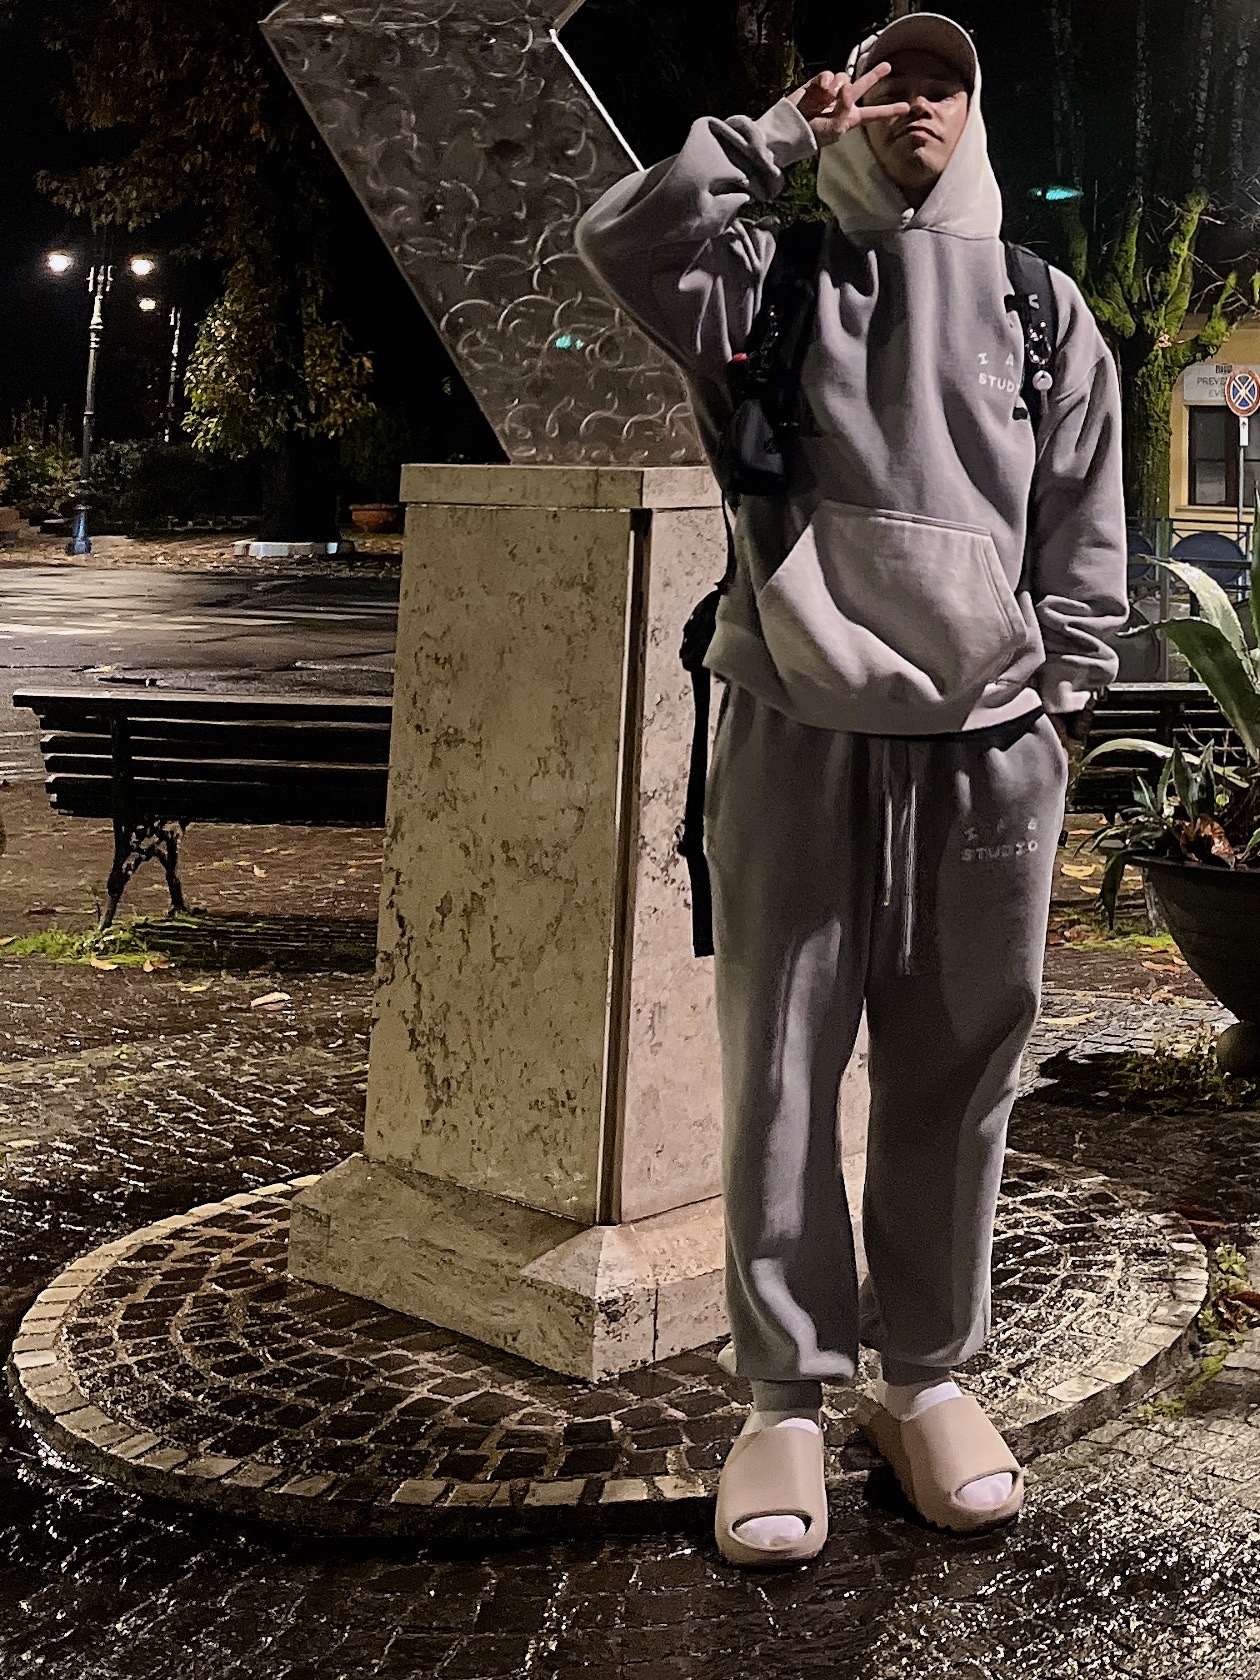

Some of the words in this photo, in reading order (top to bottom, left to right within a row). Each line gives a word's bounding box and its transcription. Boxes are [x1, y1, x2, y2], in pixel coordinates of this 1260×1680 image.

[979, 372, 1021, 393] STUD
[1196, 376, 1227, 386] PREVE
[961, 840, 1039, 861] STUDIO
